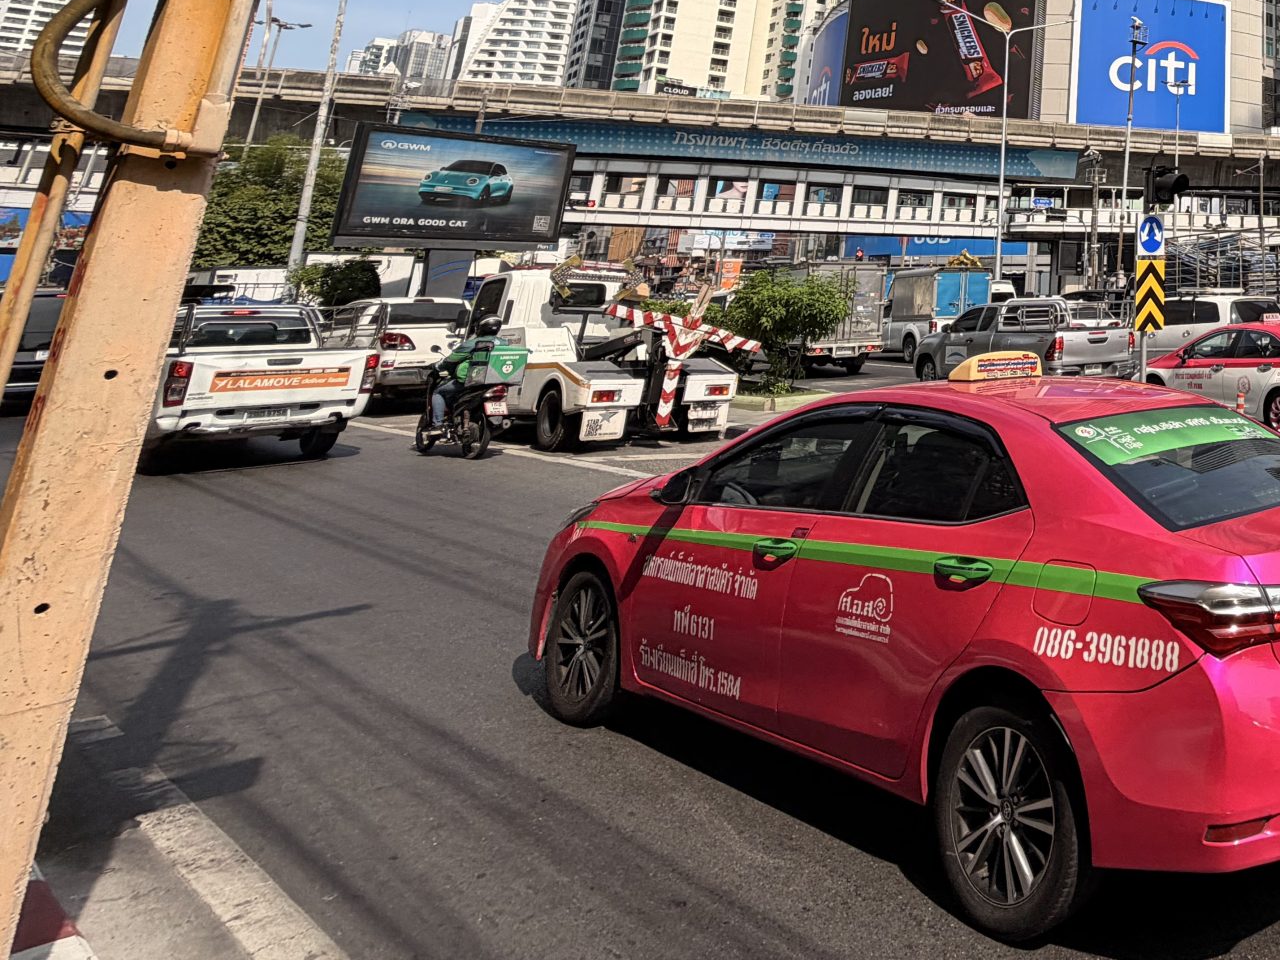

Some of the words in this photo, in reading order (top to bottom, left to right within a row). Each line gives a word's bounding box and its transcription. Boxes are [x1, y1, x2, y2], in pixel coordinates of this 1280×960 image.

[860, 21, 898, 55] ใหม่
[953, 12, 981, 58] SNICKERS
[1108, 50, 1196, 96] citi
[663, 86, 689, 96] CLOUD
[852, 83, 894, 102] ลองเลย!
[397, 142, 431, 152] GWM
[363, 216, 389, 224] GWM
[392, 217, 414, 225] ORA
[417, 219, 446, 227] GOOD
[448, 219, 468, 228] CAT
[226, 377, 301, 390] LALAMOVE
[301, 376, 326, 385] deliver
[1032, 626, 1180, 672] 086-3961888
